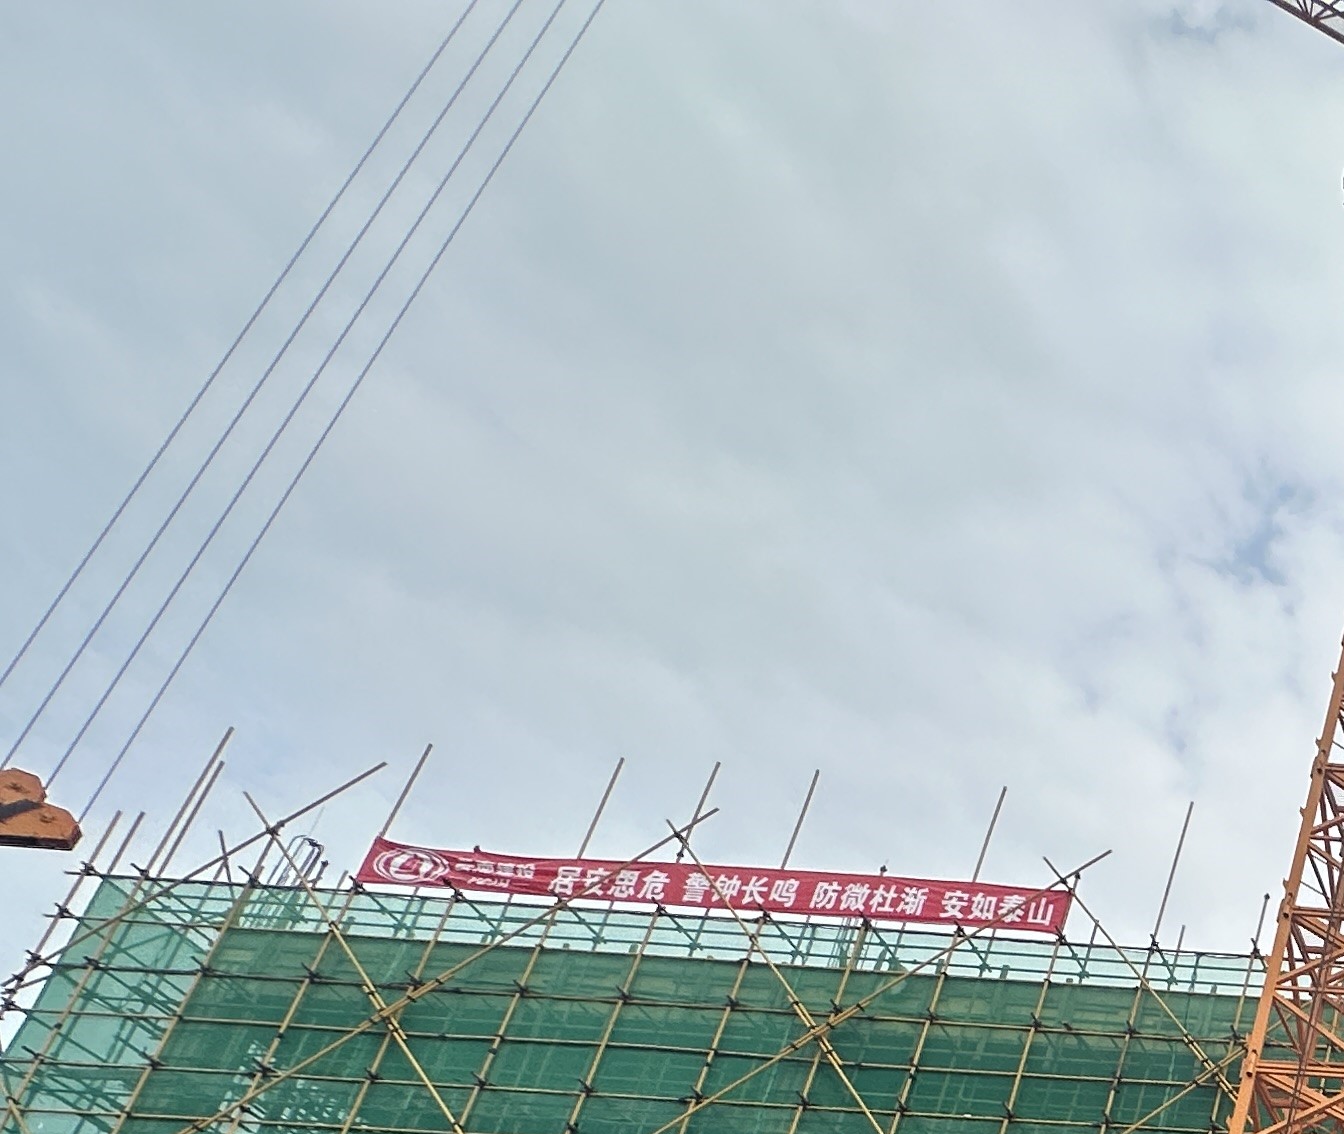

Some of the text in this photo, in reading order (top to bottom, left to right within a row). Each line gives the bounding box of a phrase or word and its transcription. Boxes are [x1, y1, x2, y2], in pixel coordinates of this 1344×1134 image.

[550, 866, 1056, 927] 居安思危 警钟长鸣 防微杜渐 安如泰山
